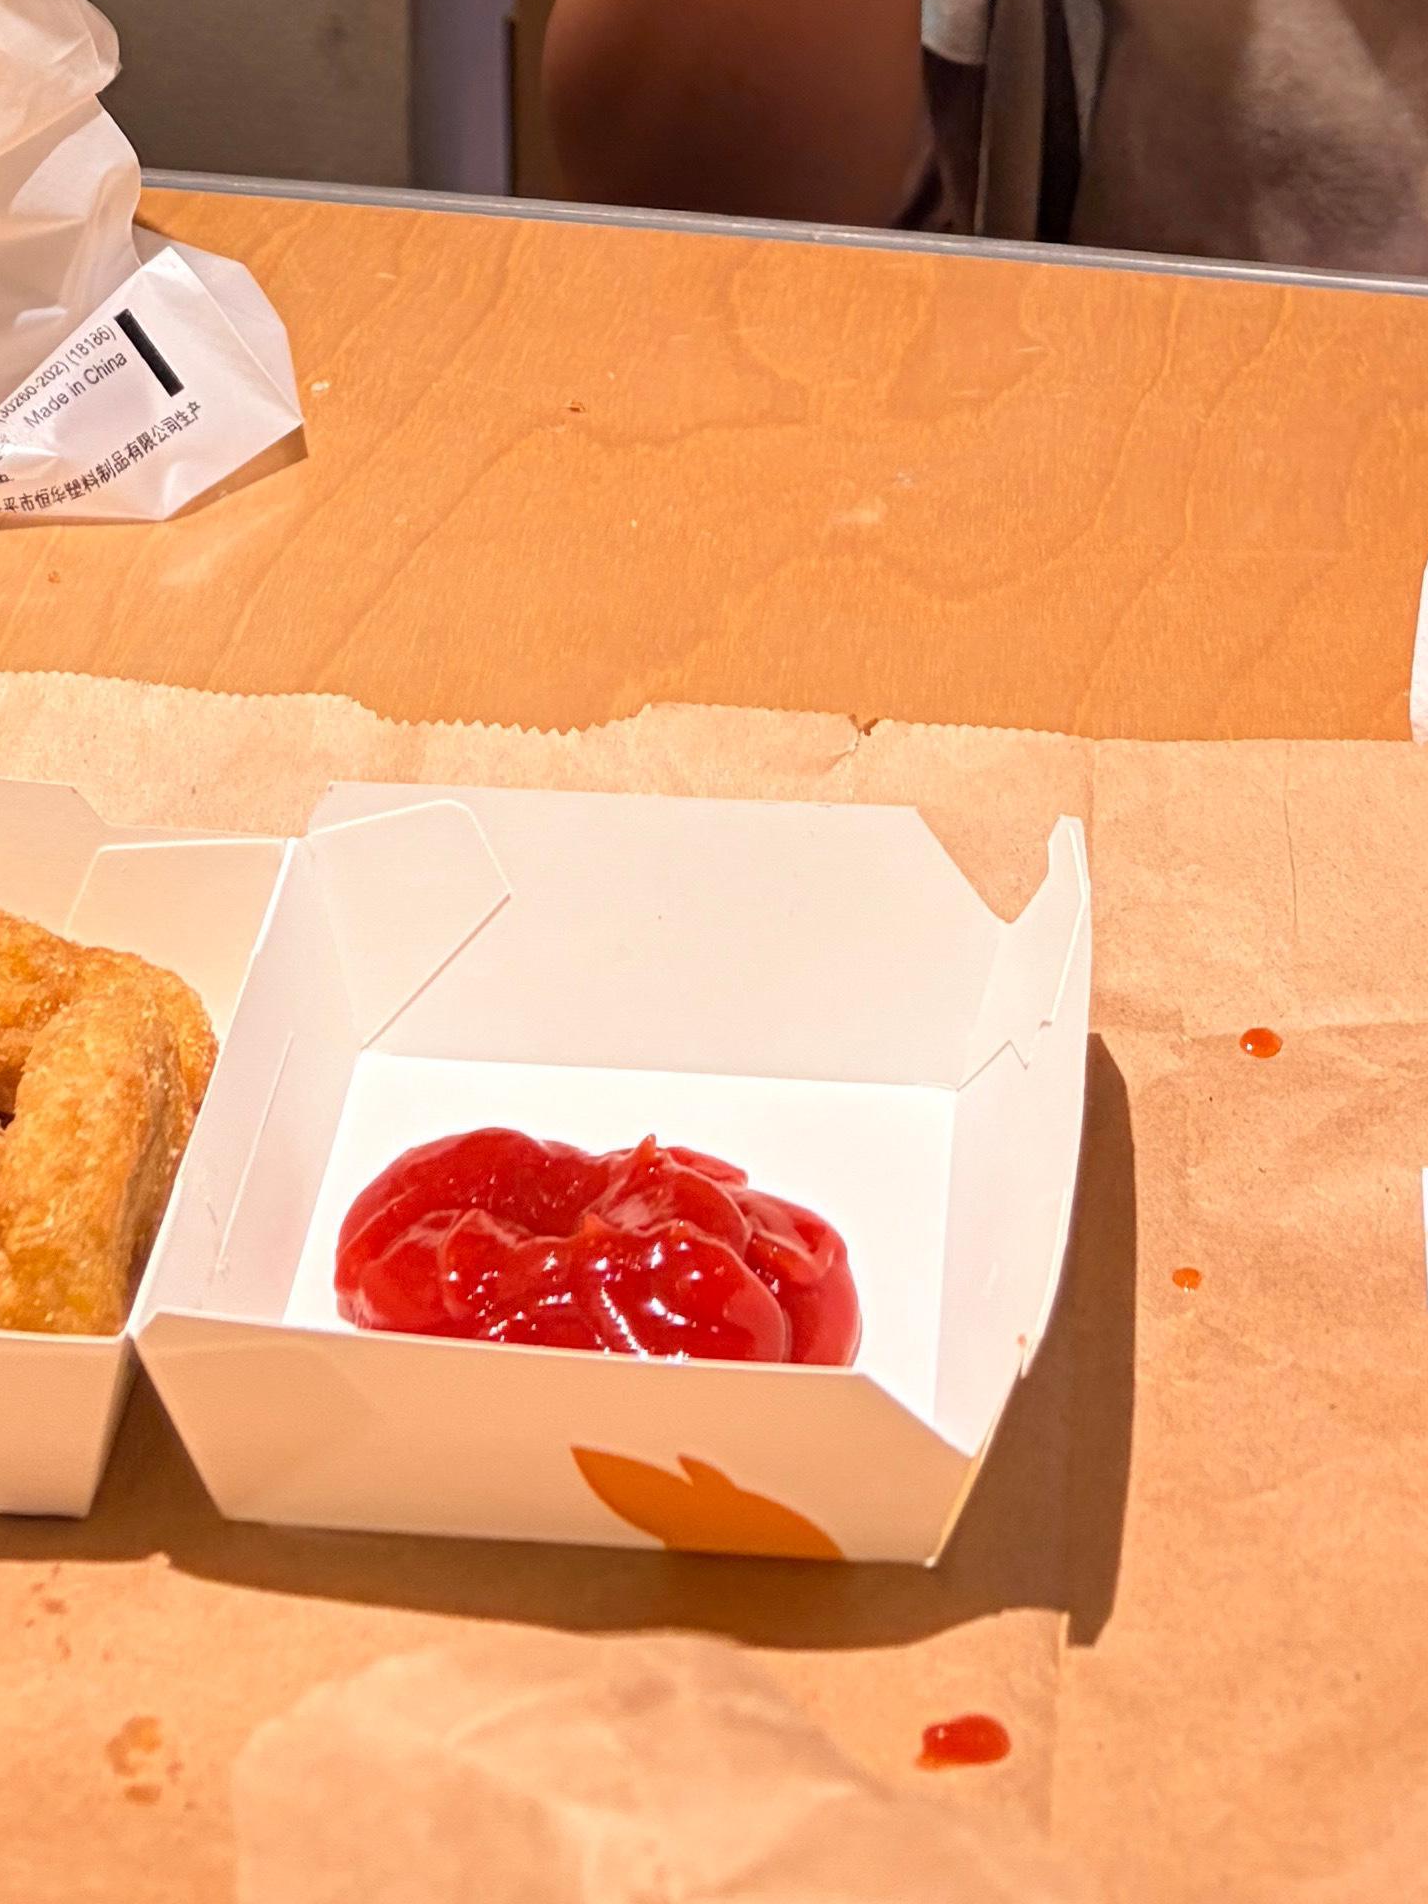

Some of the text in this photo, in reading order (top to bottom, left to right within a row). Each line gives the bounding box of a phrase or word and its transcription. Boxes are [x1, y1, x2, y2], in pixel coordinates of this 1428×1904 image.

[23, 352, 128, 428] Made in China
